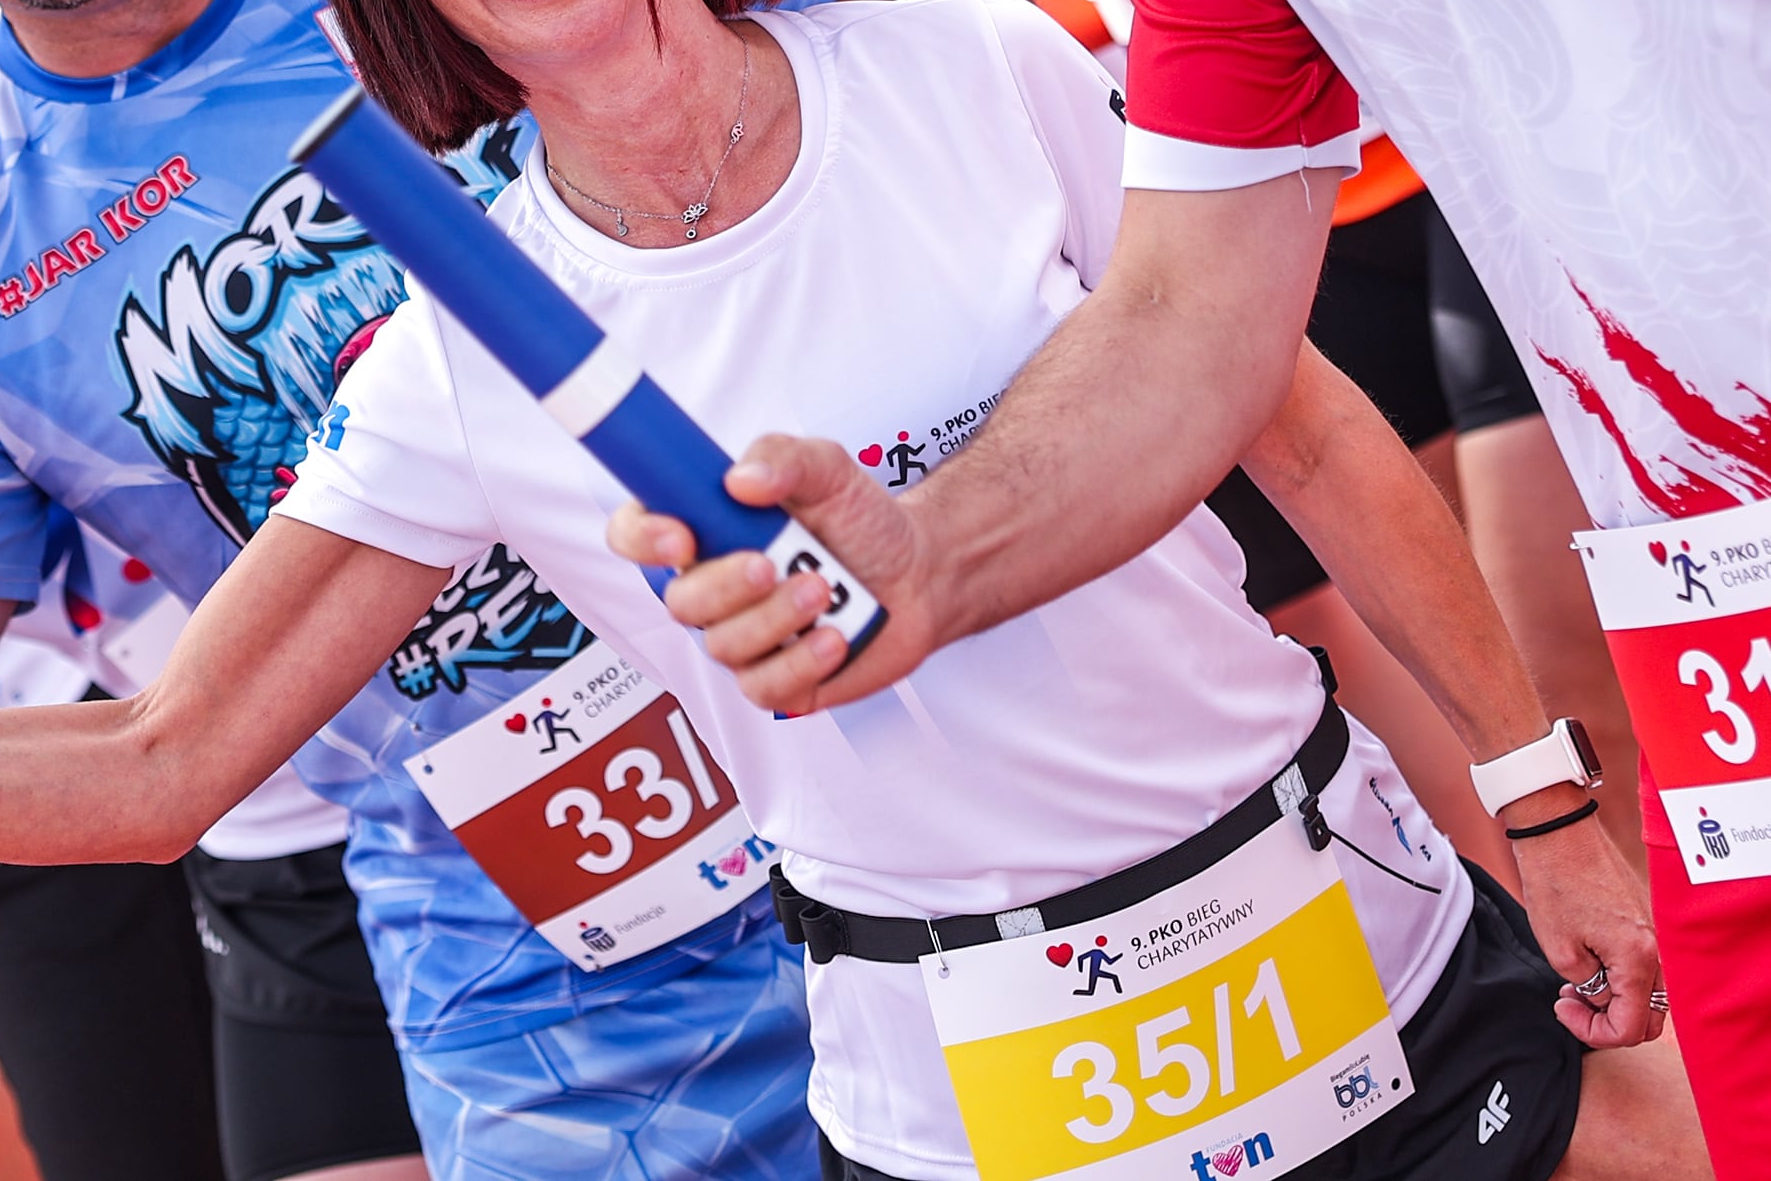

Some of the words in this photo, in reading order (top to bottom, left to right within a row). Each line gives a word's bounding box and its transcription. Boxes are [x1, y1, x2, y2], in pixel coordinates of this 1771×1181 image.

[97, 153, 201, 246] KOR
[116, 164, 373, 464] MOR
[944, 408, 977, 434] PKO
[978, 388, 1007, 415] BIE
[938, 424, 980, 456] CHAR
[1725, 542, 1760, 564] PKO
[586, 666, 620, 695] PKO
[1137, 898, 1255, 971] CHARYTATYWNY
[1148, 918, 1183, 946] PKO
[1186, 898, 1222, 928] BIEG
[1051, 956, 1303, 1145] 35/1
[1342, 1091, 1383, 1123] POLSKA
